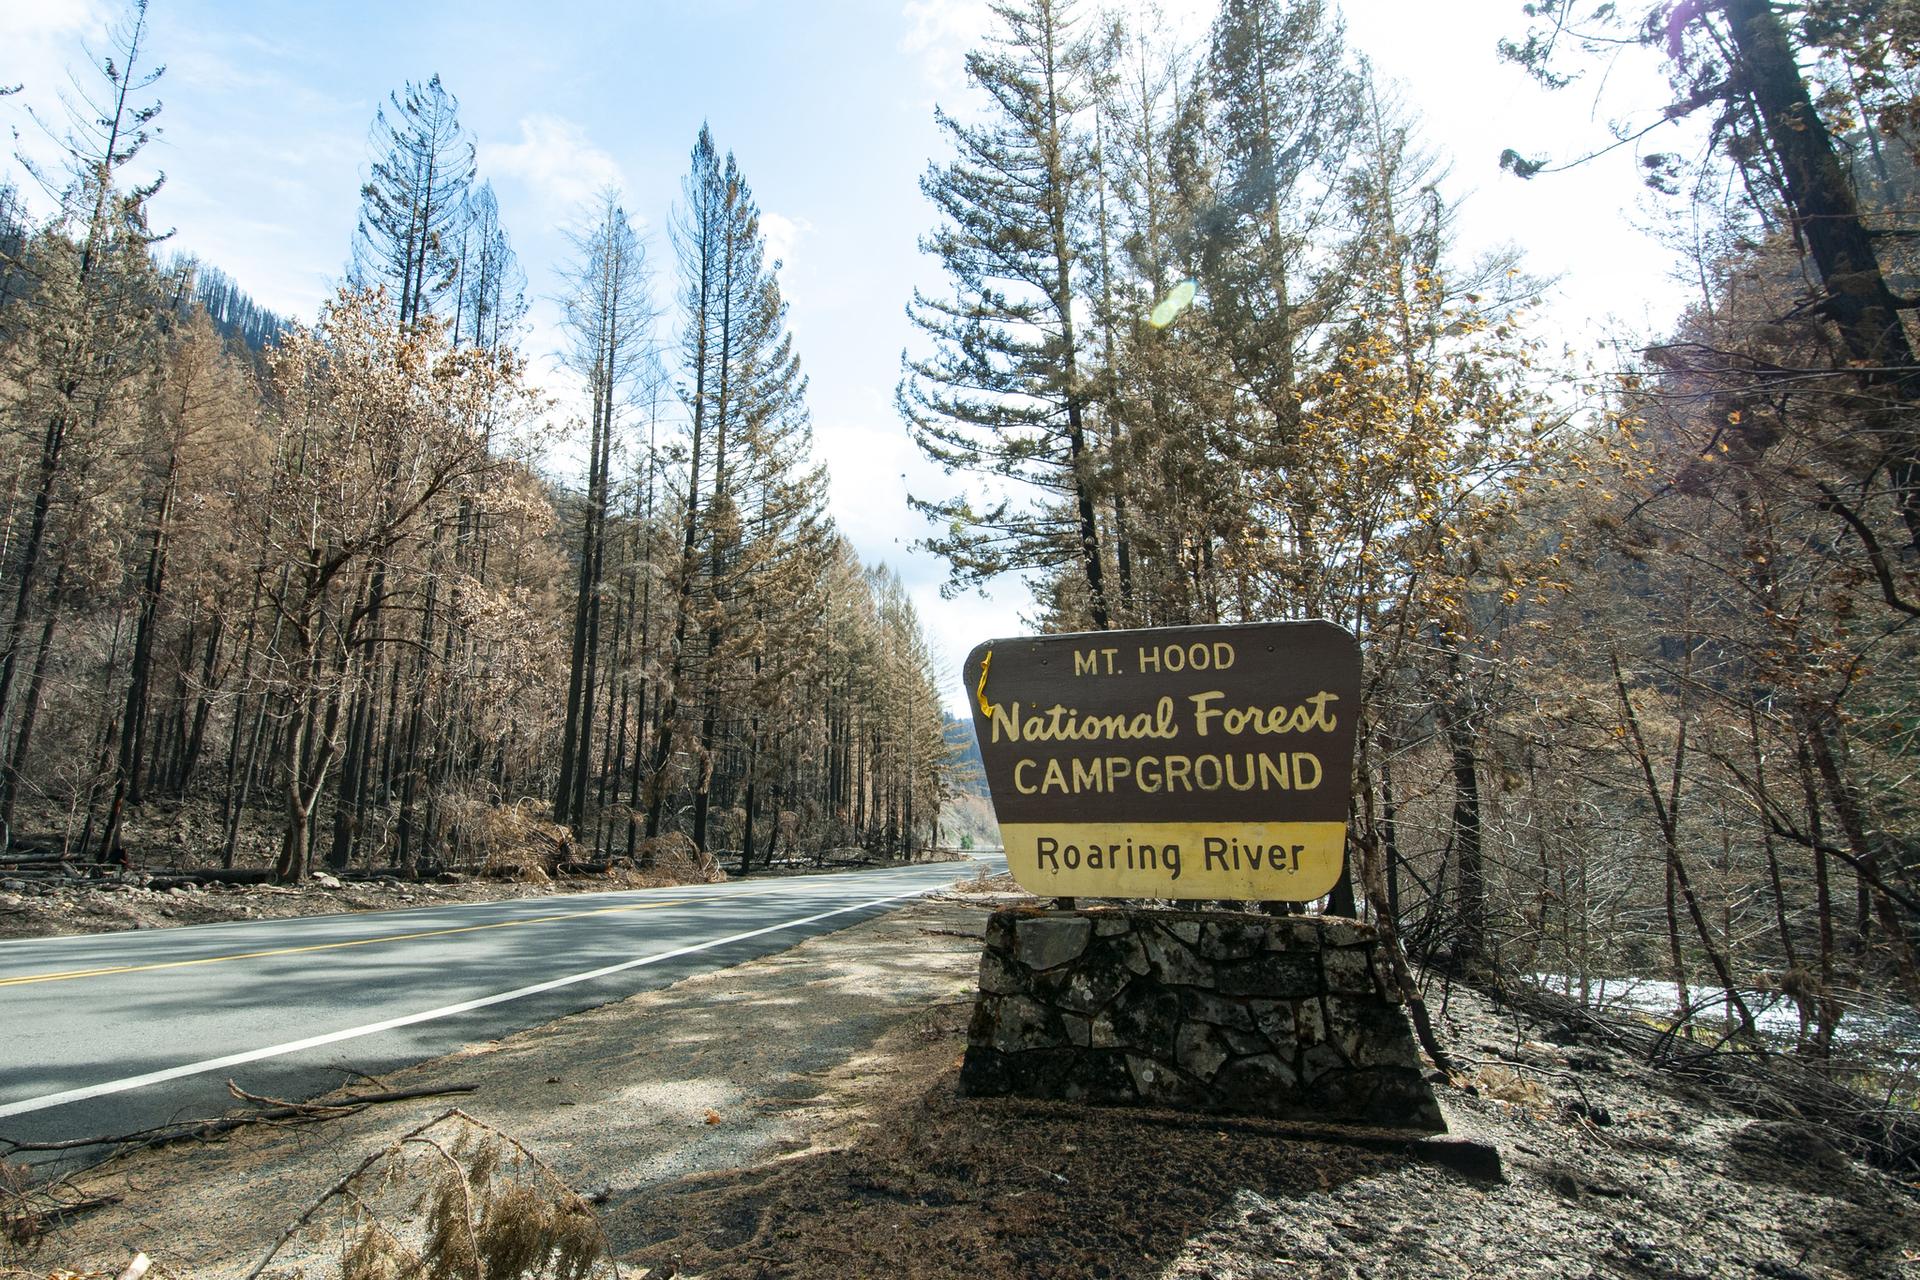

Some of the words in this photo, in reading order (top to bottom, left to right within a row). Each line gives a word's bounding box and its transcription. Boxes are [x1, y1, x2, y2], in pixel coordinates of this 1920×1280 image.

[1074, 649, 1123, 677] MT.
[1139, 642, 1235, 674] HOOD
[991, 696, 1179, 744] National
[1188, 690, 1340, 737] Forest
[1014, 752, 1323, 795] CAMPGROUND
[1037, 837, 1181, 881] Roaring
[1203, 836, 1305, 872] River
